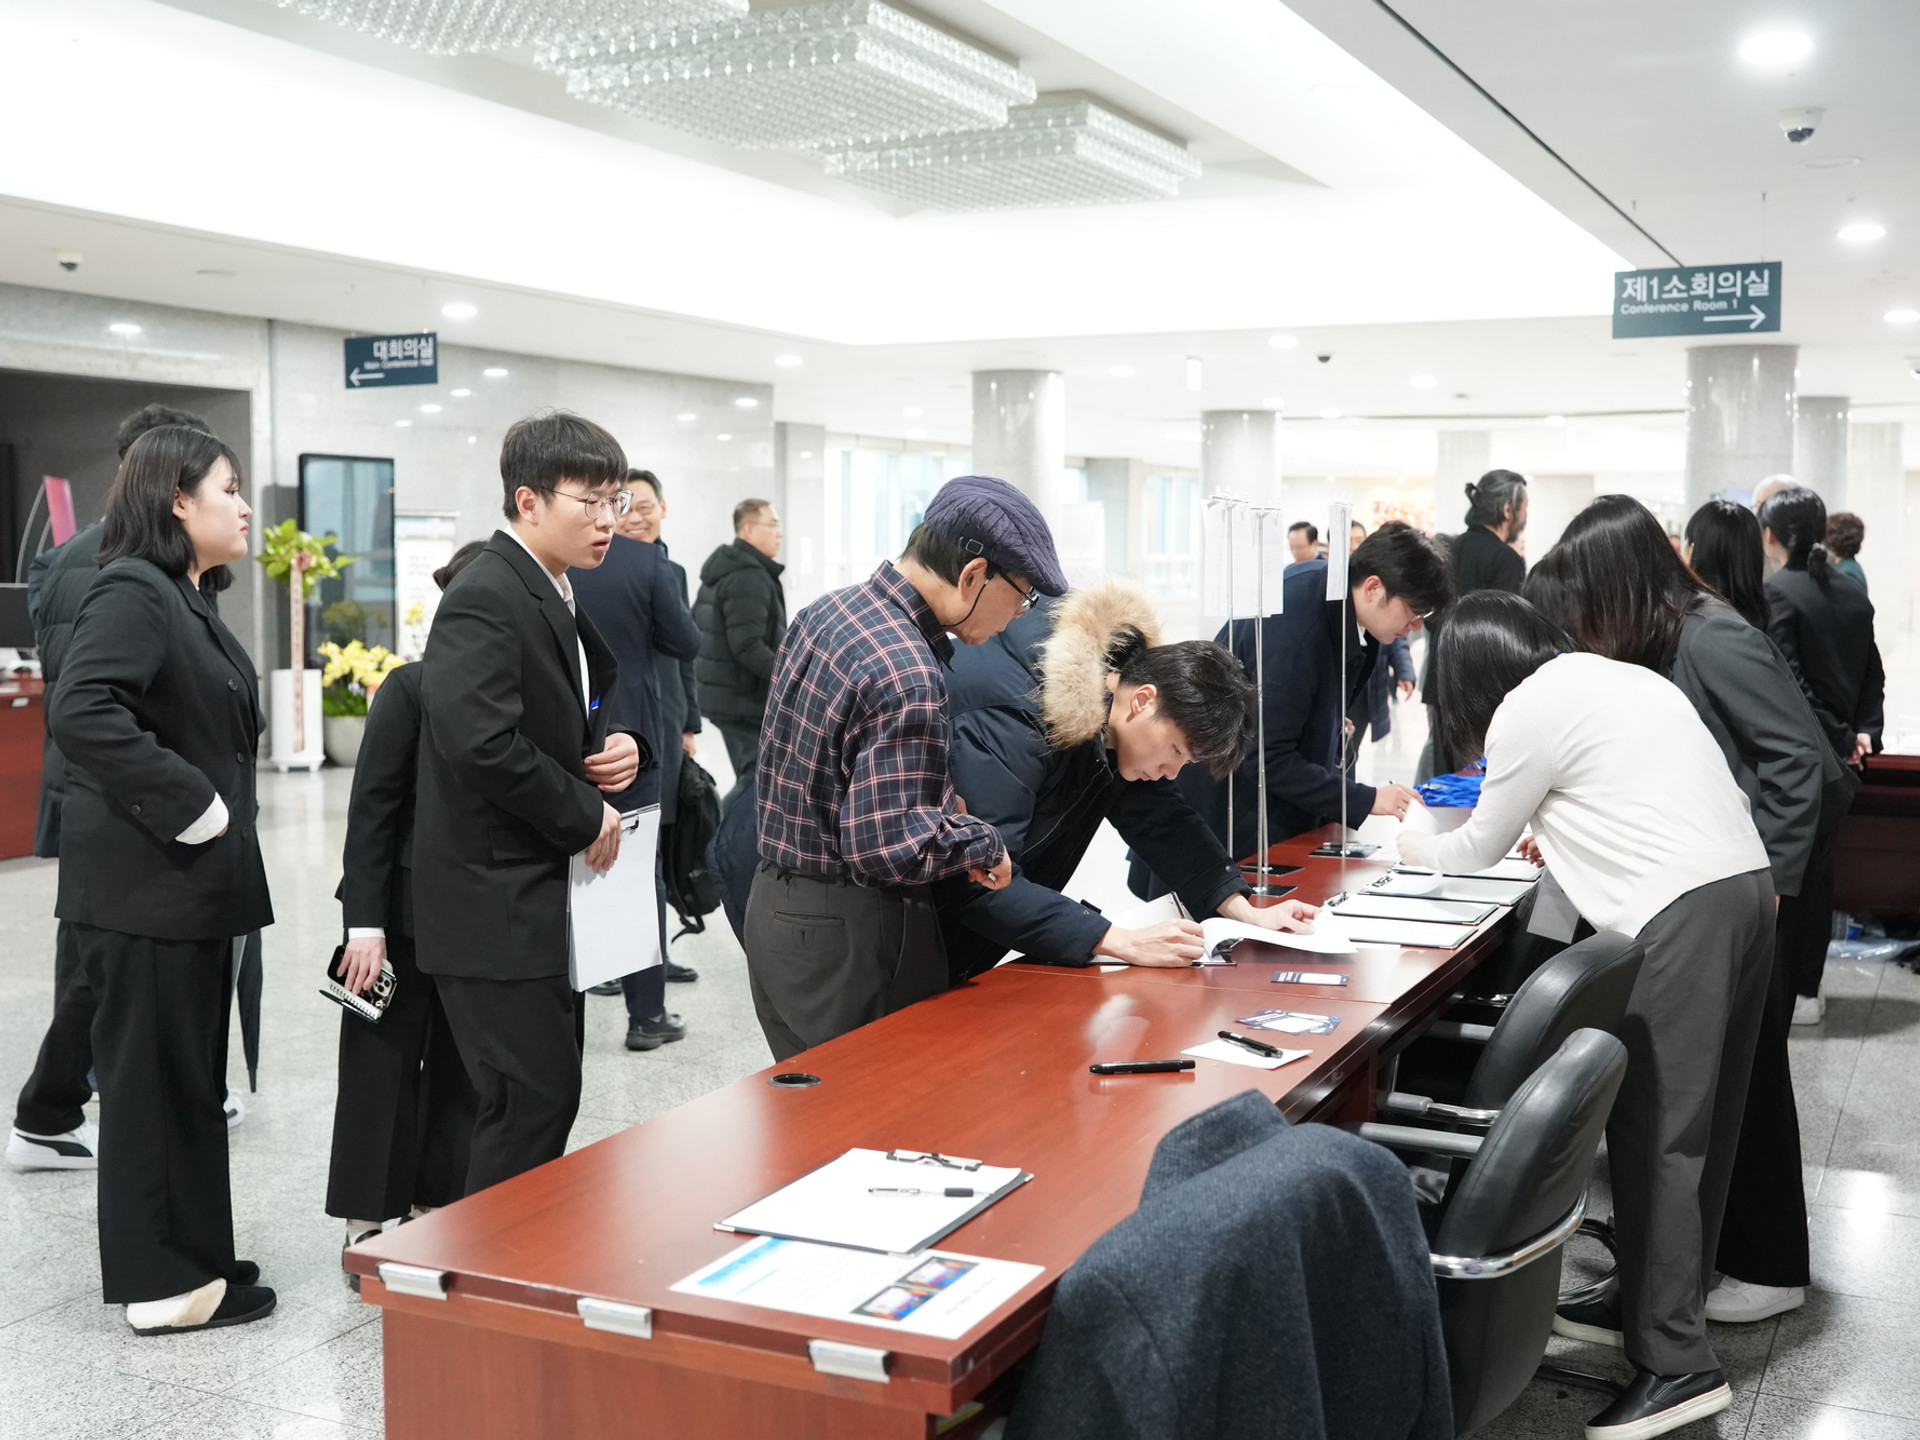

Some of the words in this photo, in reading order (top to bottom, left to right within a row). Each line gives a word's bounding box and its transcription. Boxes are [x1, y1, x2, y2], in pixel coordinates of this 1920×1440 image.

[1621, 269, 1770, 302] 제1소회의실
[1620, 302, 1689, 315] Conference
[1693, 299, 1728, 311] Room
[1732, 298, 1738, 310] 1
[373, 336, 434, 360] 대회의실
